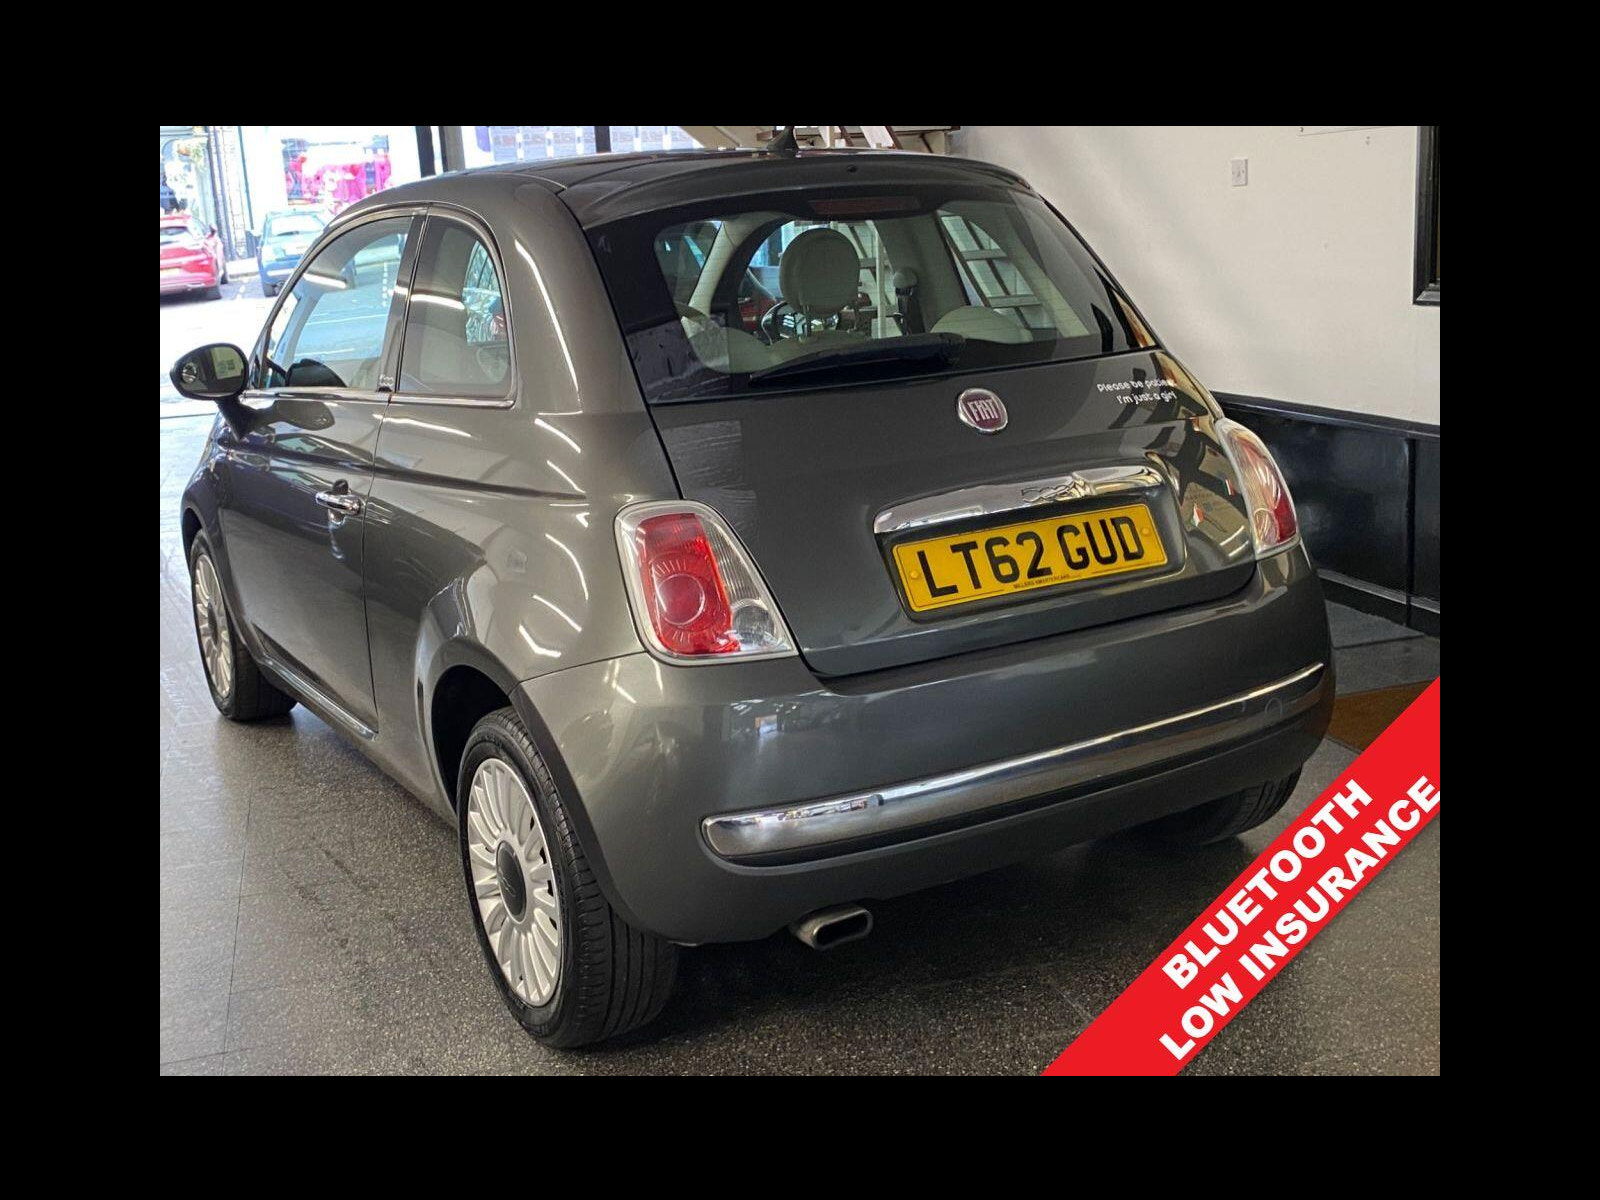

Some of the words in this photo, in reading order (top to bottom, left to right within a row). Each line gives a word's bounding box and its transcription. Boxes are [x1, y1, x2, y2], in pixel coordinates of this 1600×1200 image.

[1097, 381, 1130, 392] Please
[1116, 395, 1133, 404] I'm
[1132, 392, 1153, 405] just
[966, 399, 999, 422] FIAT
[917, 530, 1053, 598] LT62
[1056, 516, 1145, 571] GUD
